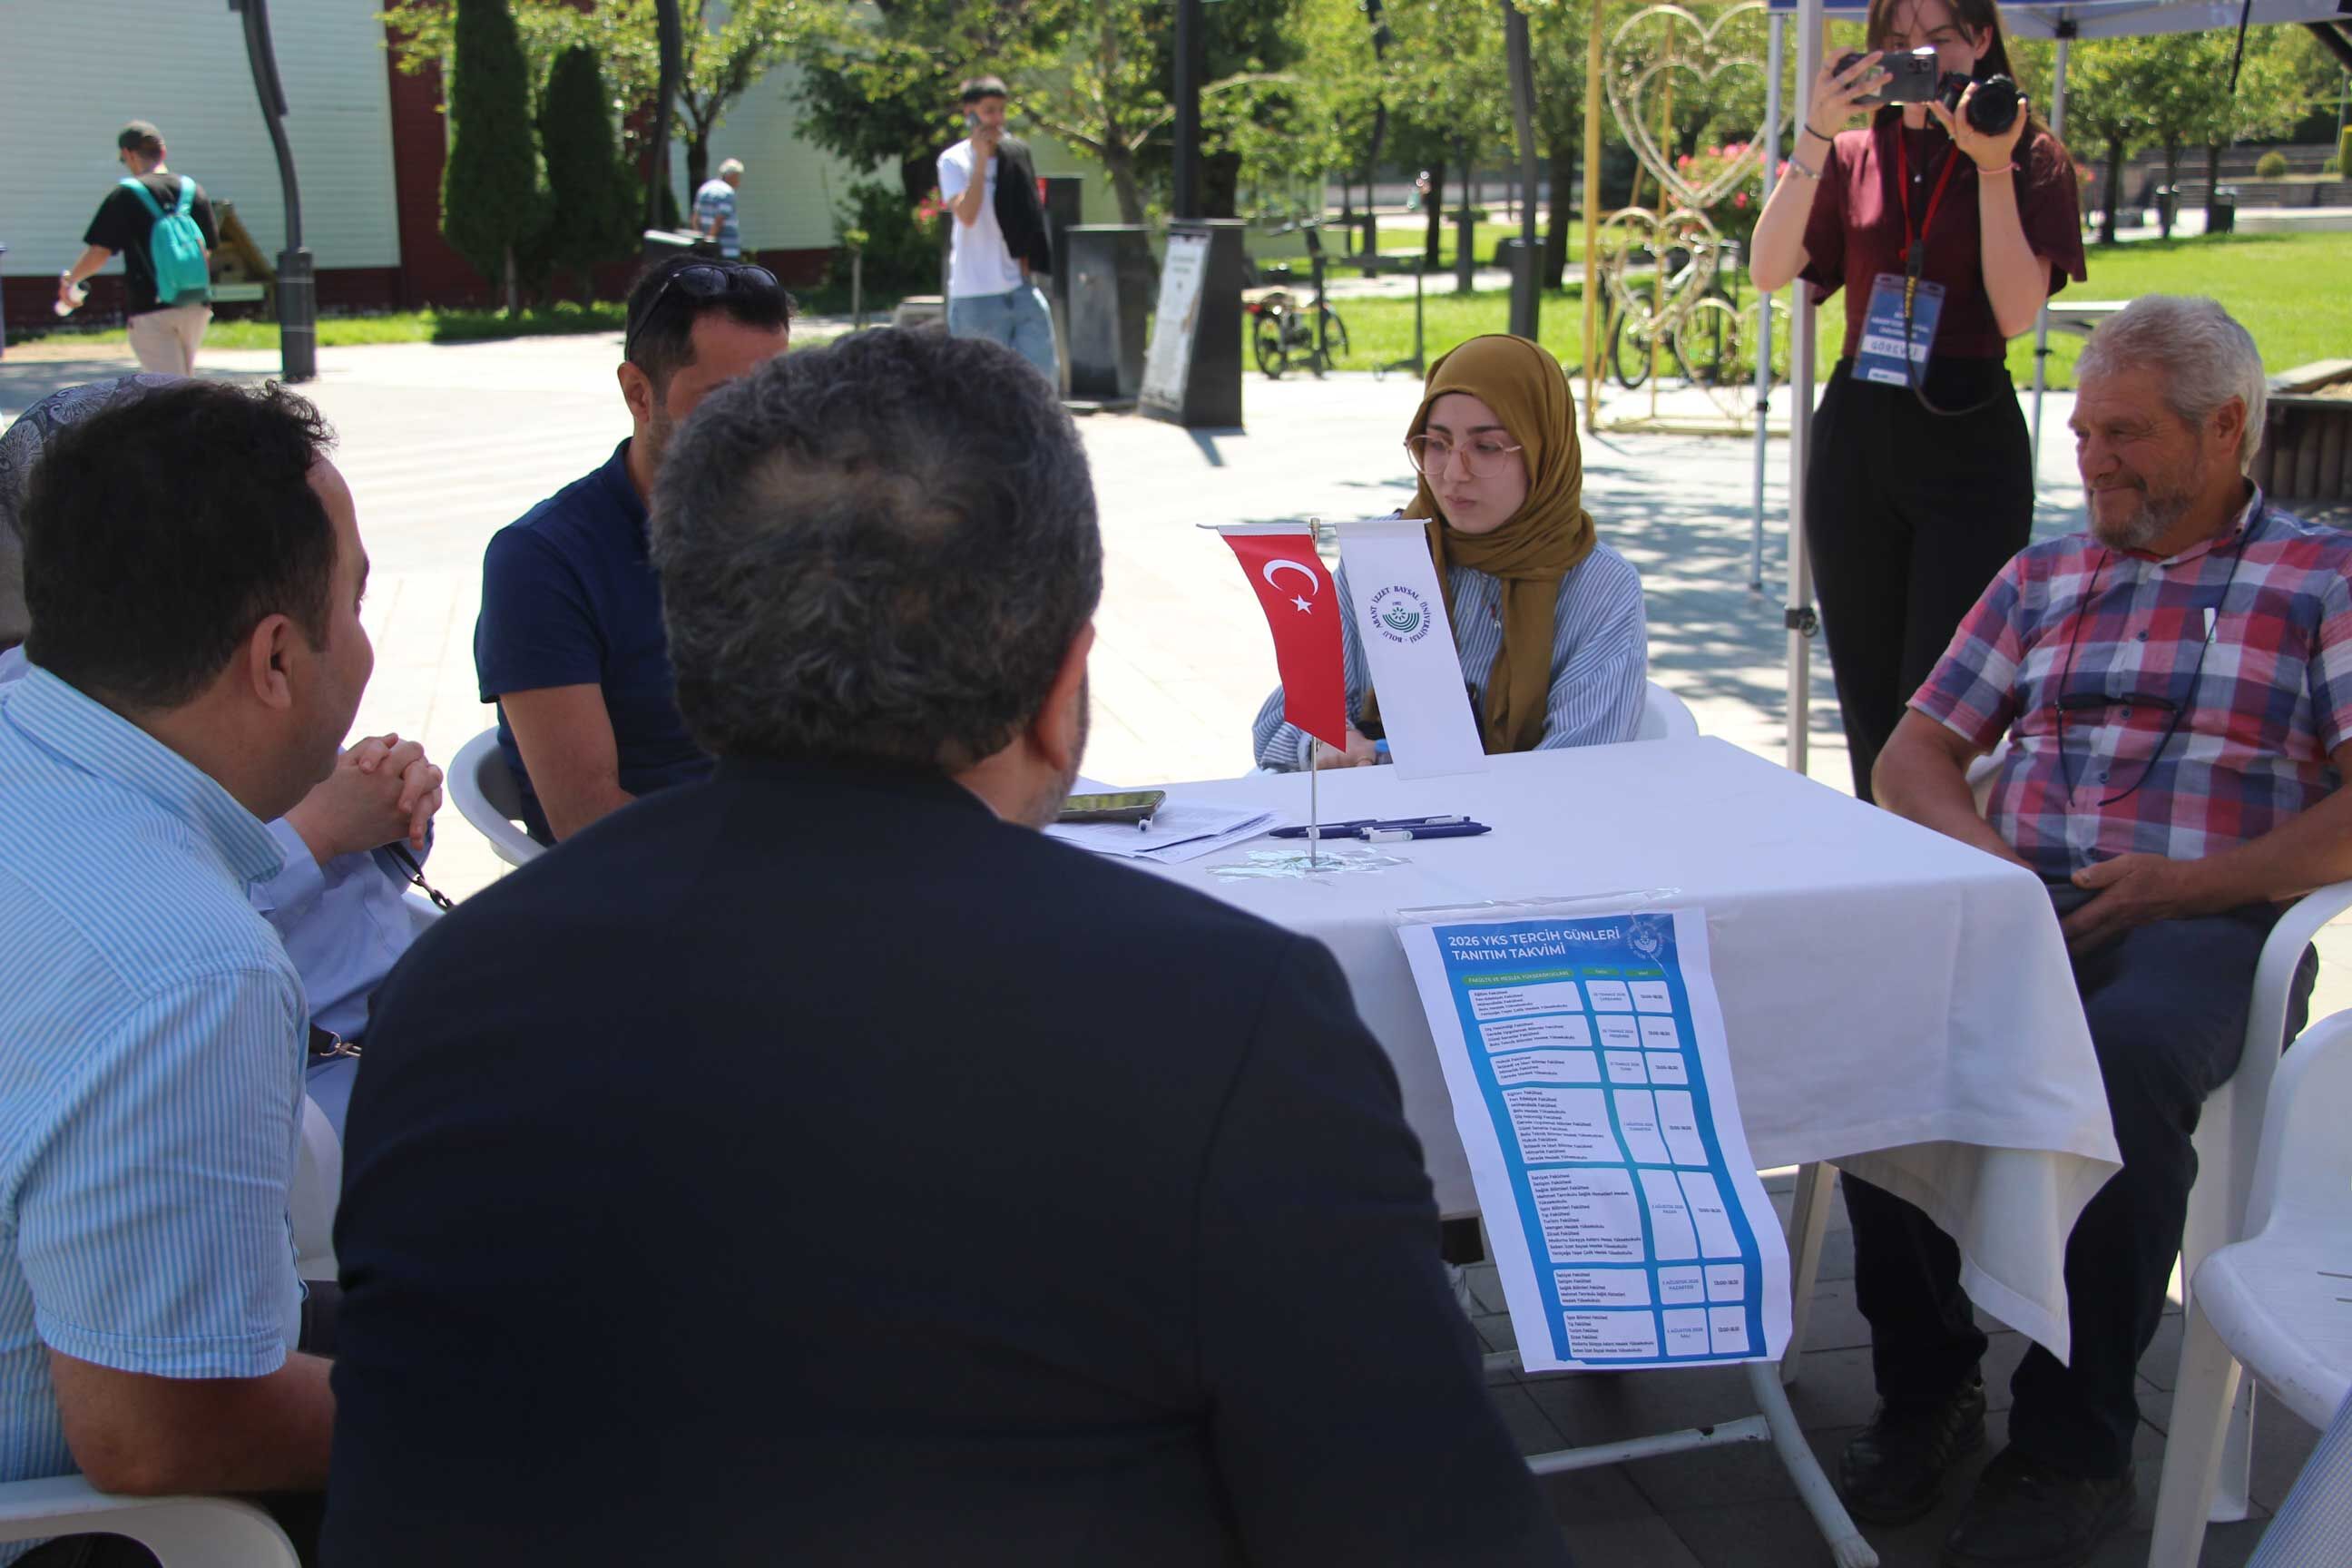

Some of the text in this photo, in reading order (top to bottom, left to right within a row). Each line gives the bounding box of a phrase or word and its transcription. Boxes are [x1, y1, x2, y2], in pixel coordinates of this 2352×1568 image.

[1872, 341, 1916, 356] GÖREVİ
[1372, 587, 1389, 603] İZZET
[1394, 586, 1419, 601] BAYSAL
[1370, 606, 1383, 628] ABANT
[1383, 631, 1402, 642] BOLU
[1448, 926, 1620, 946] 2026 YKS TERCİH GÜNLERİ
[1452, 944, 1565, 961] TANITIM TAKVİMİ
